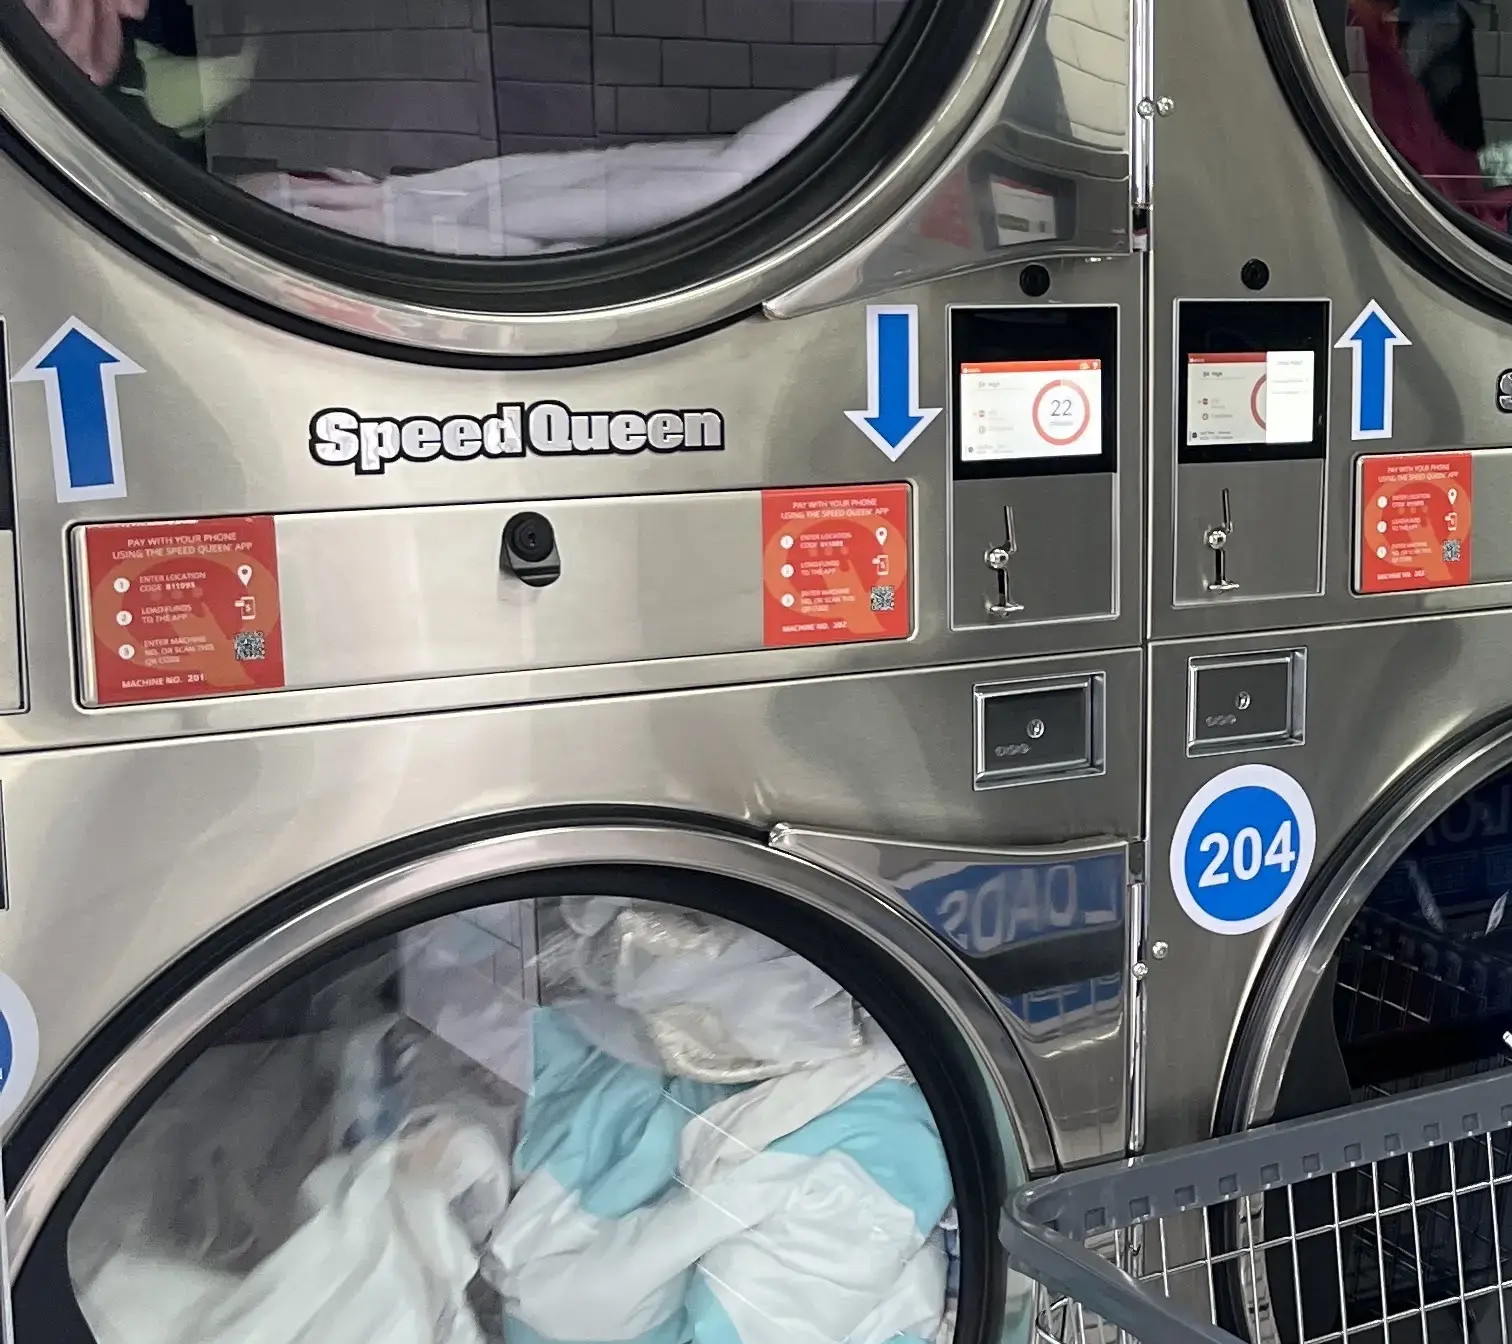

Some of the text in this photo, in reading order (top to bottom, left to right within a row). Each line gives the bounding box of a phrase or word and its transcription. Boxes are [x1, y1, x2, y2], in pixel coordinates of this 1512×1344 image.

[1050, 399, 1073, 417] 22
[127, 532, 237, 547] PAY WITH YOUR PHONE
[112, 549, 144, 560] USING
[145, 547, 163, 557] THE
[165, 545, 195, 556] SPEED
[234, 541, 253, 552] APP
[121, 677, 164, 689] MACHINE
[187, 673, 205, 683] 201
[1198, 820, 1296, 888] 204
